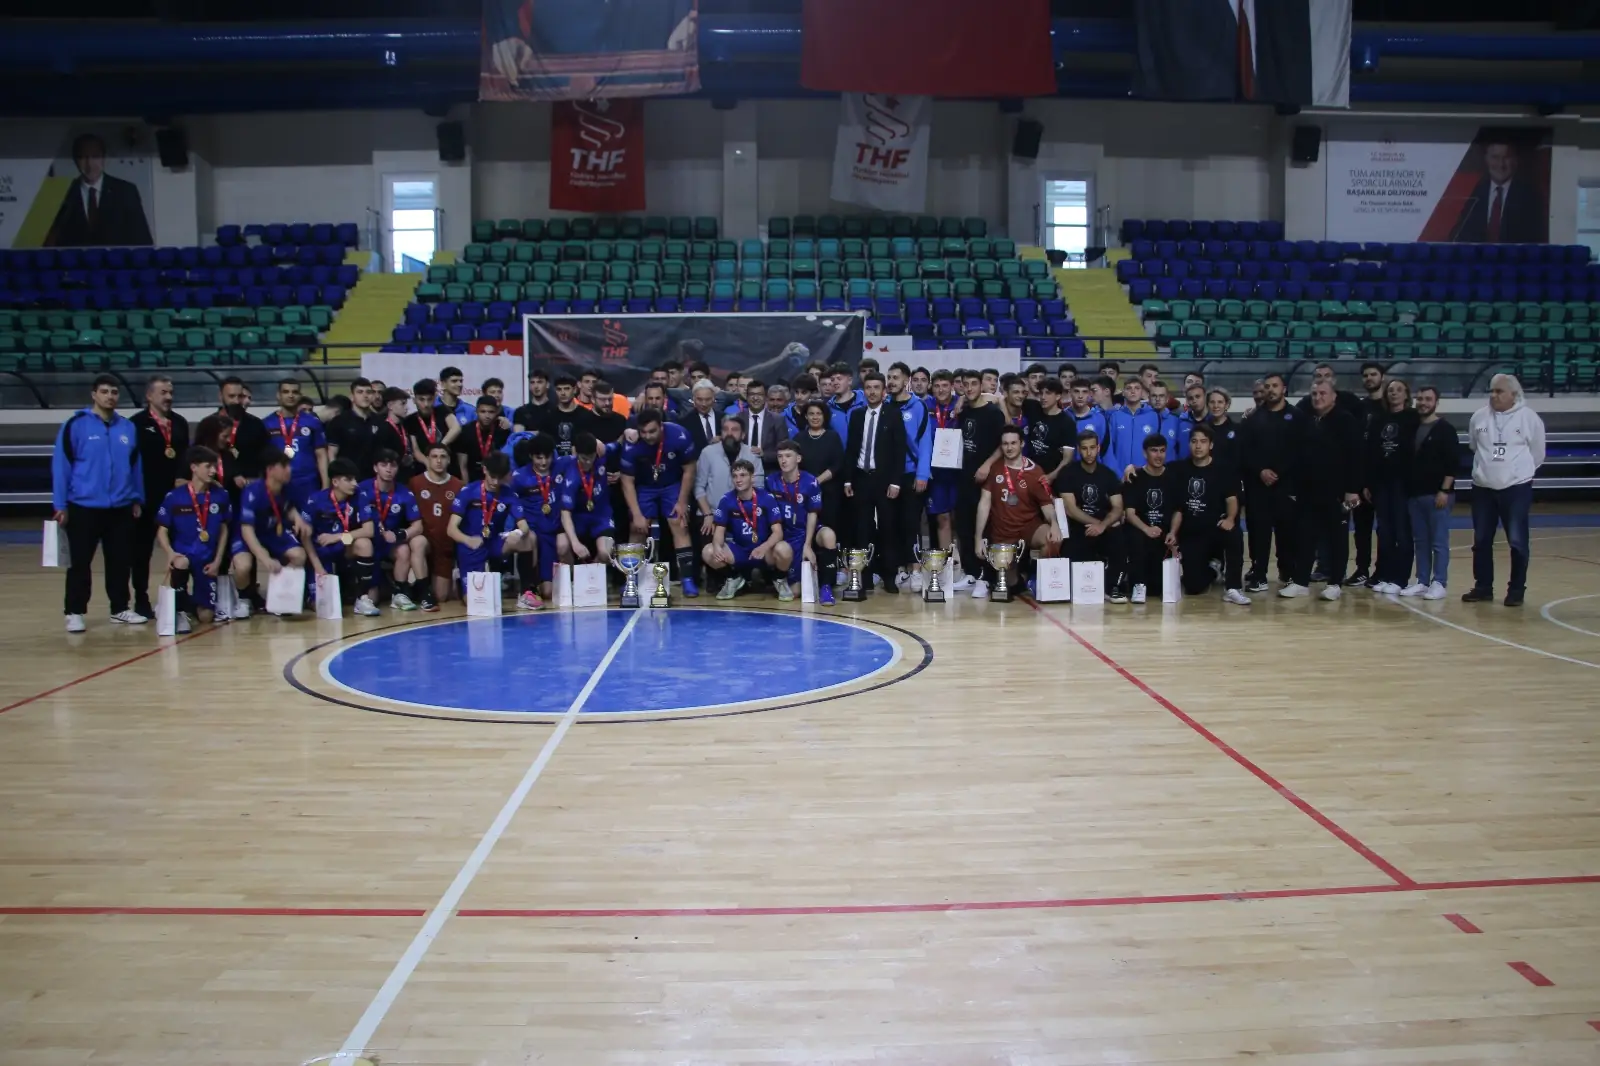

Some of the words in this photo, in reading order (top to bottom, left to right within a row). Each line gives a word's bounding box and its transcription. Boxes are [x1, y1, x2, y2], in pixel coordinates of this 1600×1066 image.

[570, 148, 626, 171] THF
[856, 142, 910, 169] THF
[601, 346, 629, 358] THF
[1001, 488, 1009, 502] 3
[433, 503, 443, 517] 6
[784, 505, 792, 519] 5
